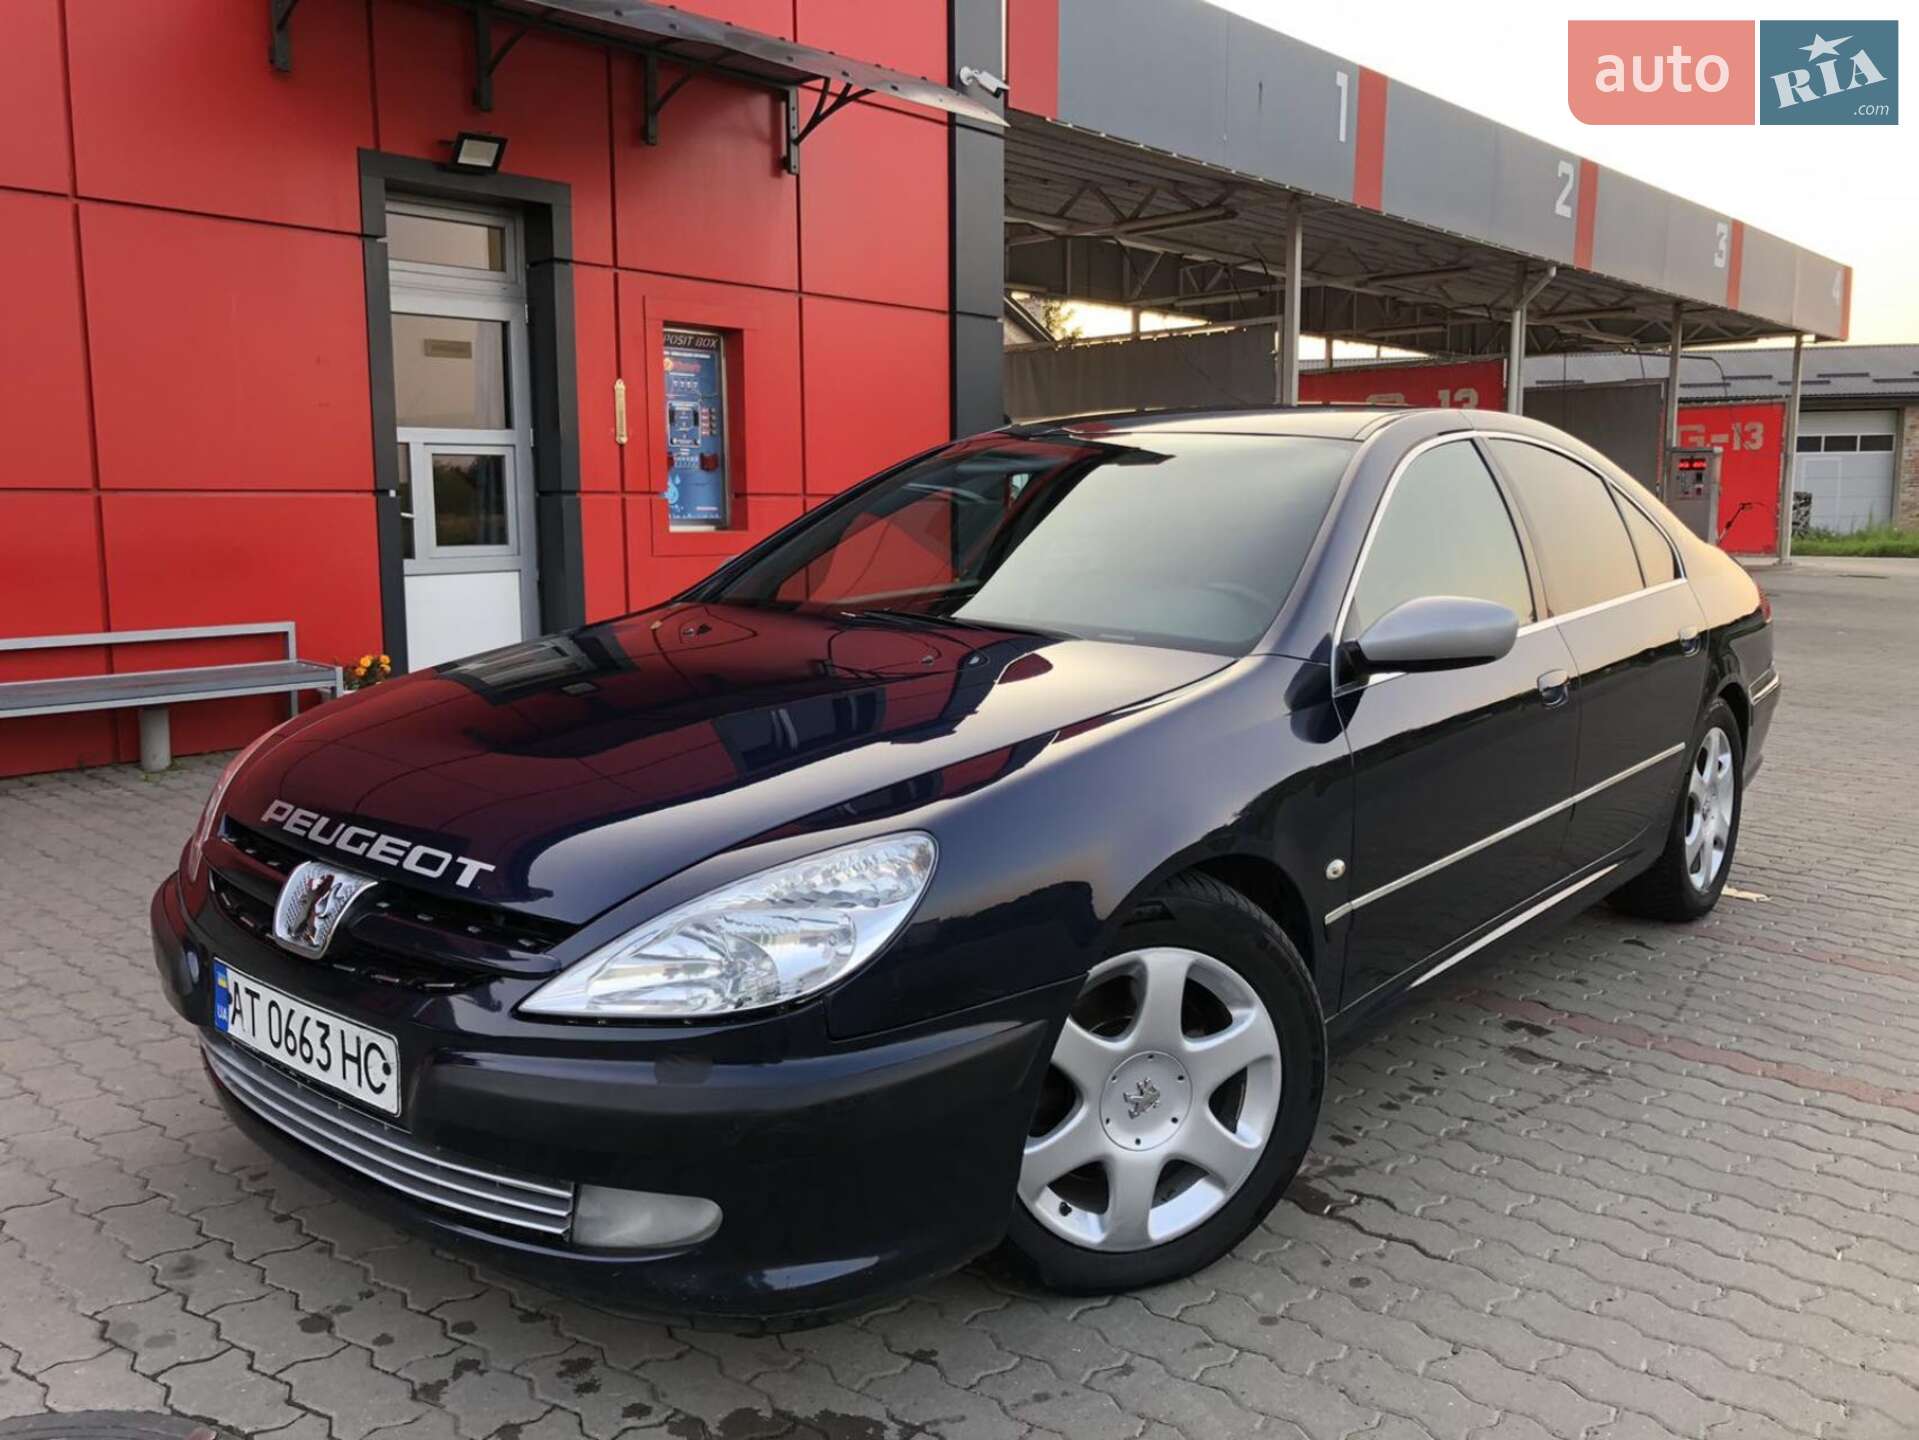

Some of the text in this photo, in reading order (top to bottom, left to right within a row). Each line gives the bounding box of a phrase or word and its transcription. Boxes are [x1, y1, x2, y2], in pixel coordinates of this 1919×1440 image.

[1336, 71, 1349, 143] 1
[1555, 160, 1575, 219] 2
[1714, 222, 1729, 269] 3
[695, 337, 718, 349] BOX
[261, 799, 497, 889] PEUGEOT
[230, 981, 388, 1094] AT 0663 HC
